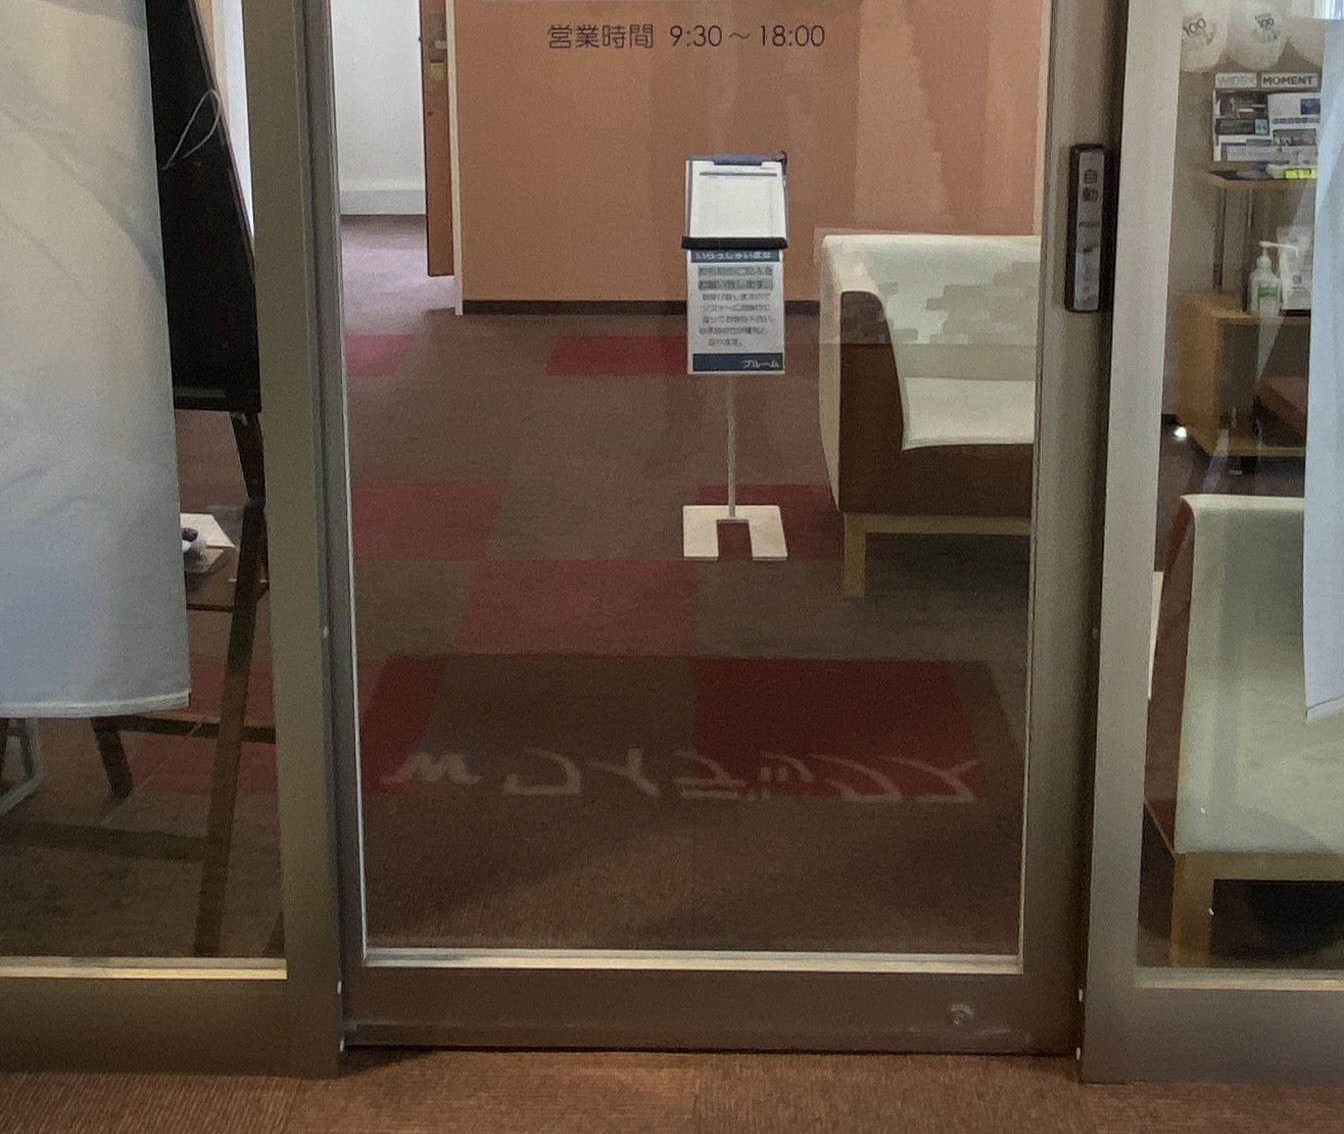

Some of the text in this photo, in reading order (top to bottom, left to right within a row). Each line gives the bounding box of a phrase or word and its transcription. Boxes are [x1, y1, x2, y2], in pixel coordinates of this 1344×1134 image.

[547, 23, 654, 49] 営業時間
[1182, 17, 1207, 37] 100
[1262, 75, 1314, 86] MOMENT
